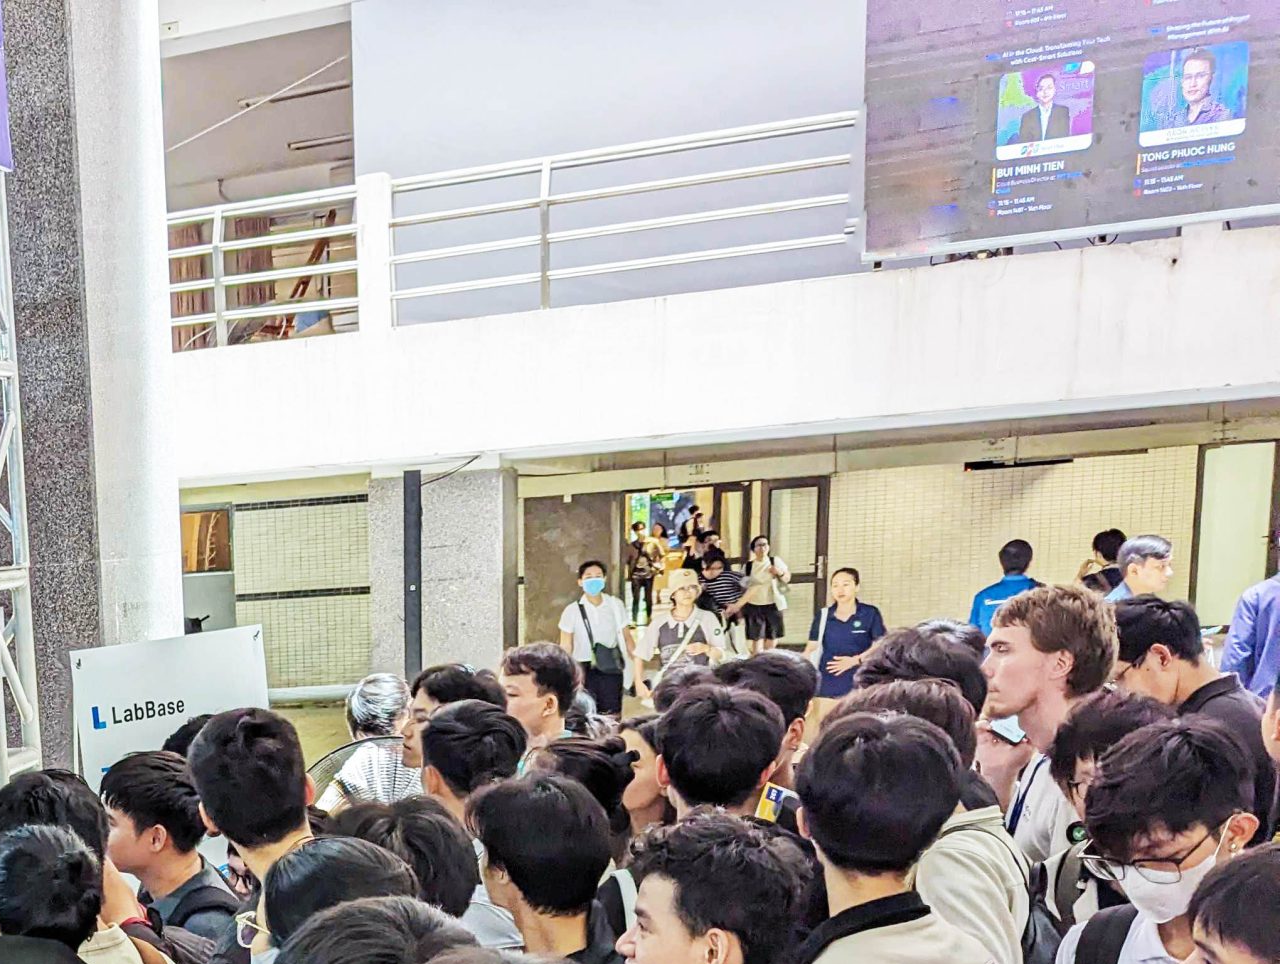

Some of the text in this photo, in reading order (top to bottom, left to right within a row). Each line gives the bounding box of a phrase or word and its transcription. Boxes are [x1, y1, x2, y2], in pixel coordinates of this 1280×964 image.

[1142, 142, 1236, 162] TONG PHUOC HUNG
[997, 160, 1065, 178] BUI MINH TIEN
[111, 699, 185, 725] LabBase
